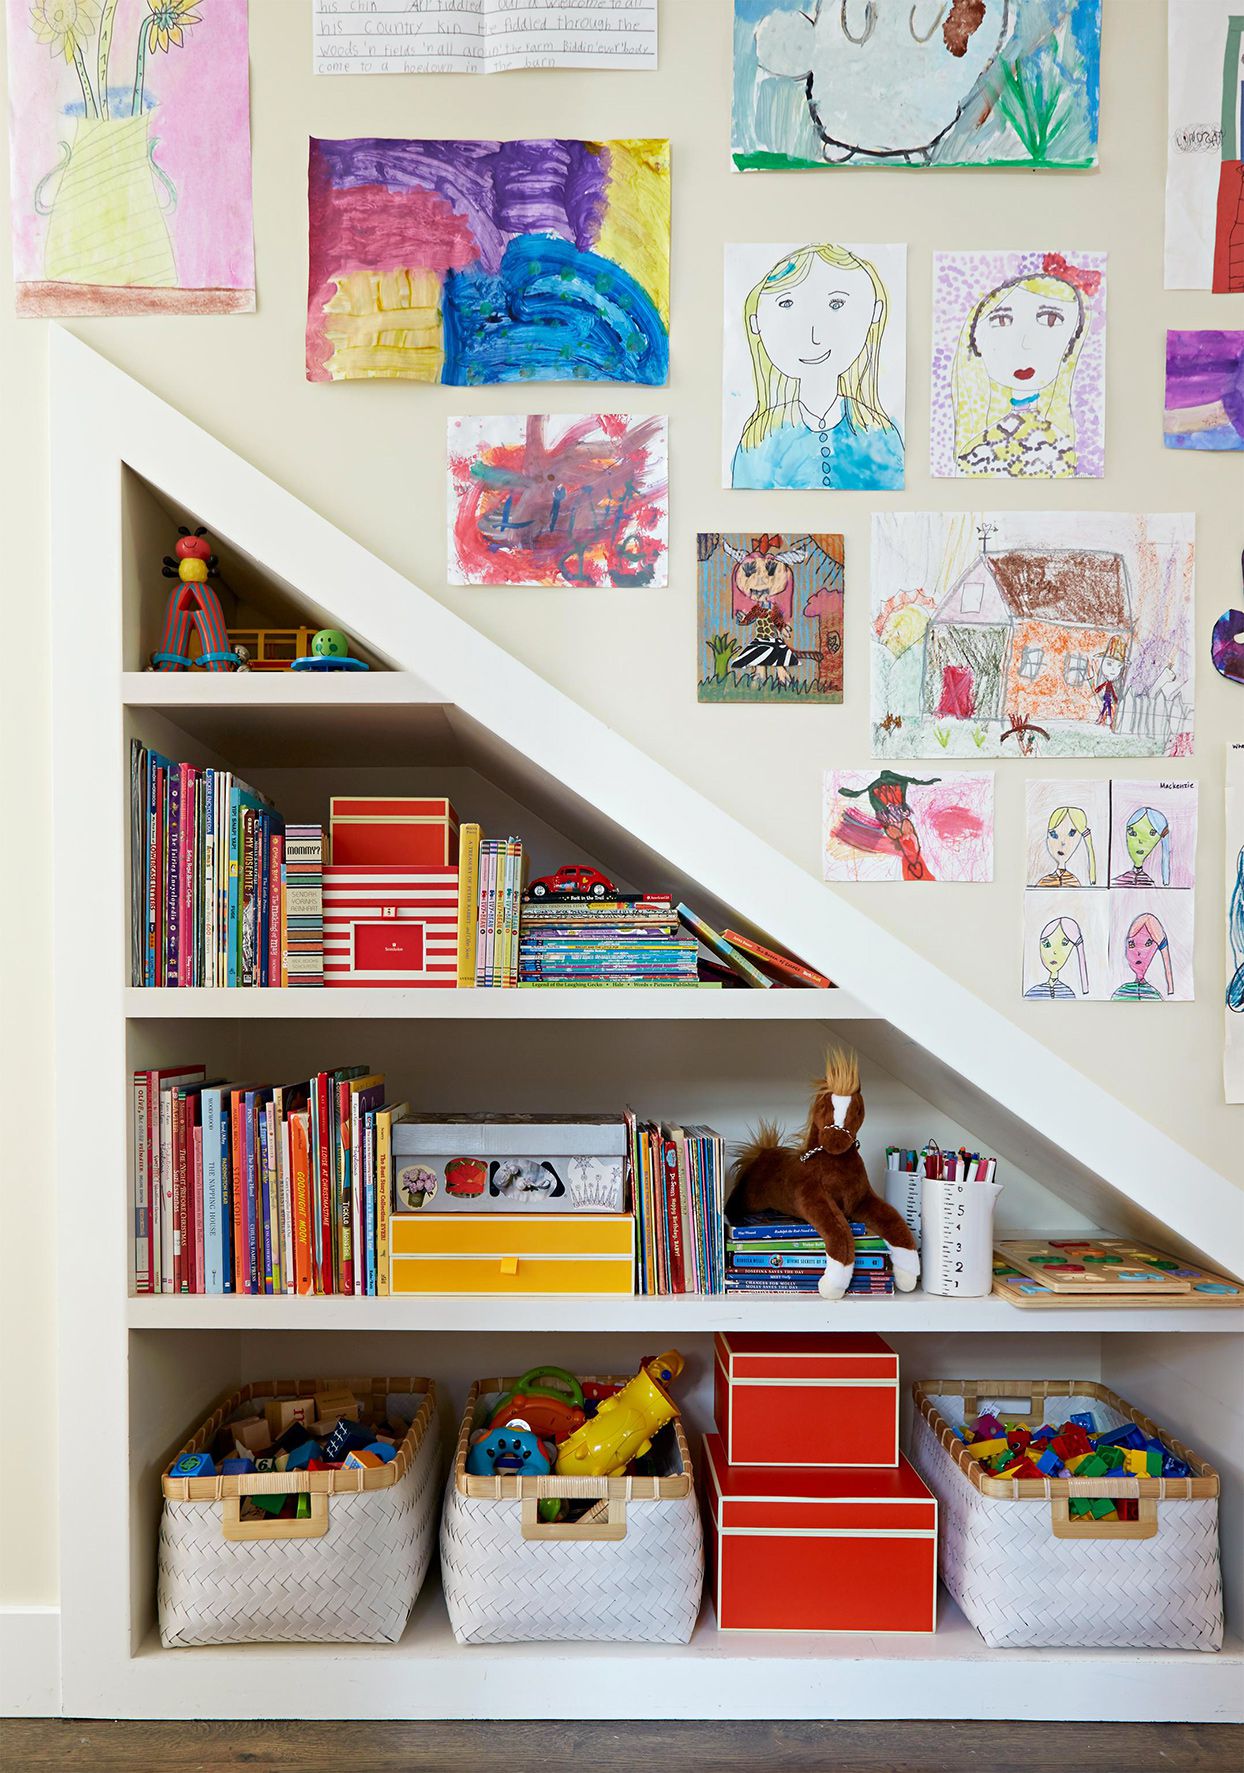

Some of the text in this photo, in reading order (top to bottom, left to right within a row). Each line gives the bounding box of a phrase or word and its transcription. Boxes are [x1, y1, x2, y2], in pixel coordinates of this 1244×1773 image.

[320, 20, 343, 34] his
[505, 16, 547, 32] fiddled
[558, 15, 612, 31] through
[618, 17, 641, 30] the
[320, 41, 358, 56] woods
[319, 63, 350, 73] come
[361, 62, 372, 73] to
[466, 61, 478, 73] in
[1160, 781, 1194, 790] Mackenzie
[246, 837, 253, 850] MY
[287, 846, 321, 856] MOMMY?
[170, 875, 178, 920] Encyclopedia
[270, 906, 279, 932] Making
[297, 1172, 307, 1245] GOODNIGHT MOON
[957, 1204, 965, 1216] 5
[956, 1242, 962, 1252] 3
[955, 1262, 964, 1272] 2
[954, 1279, 959, 1288] 1
